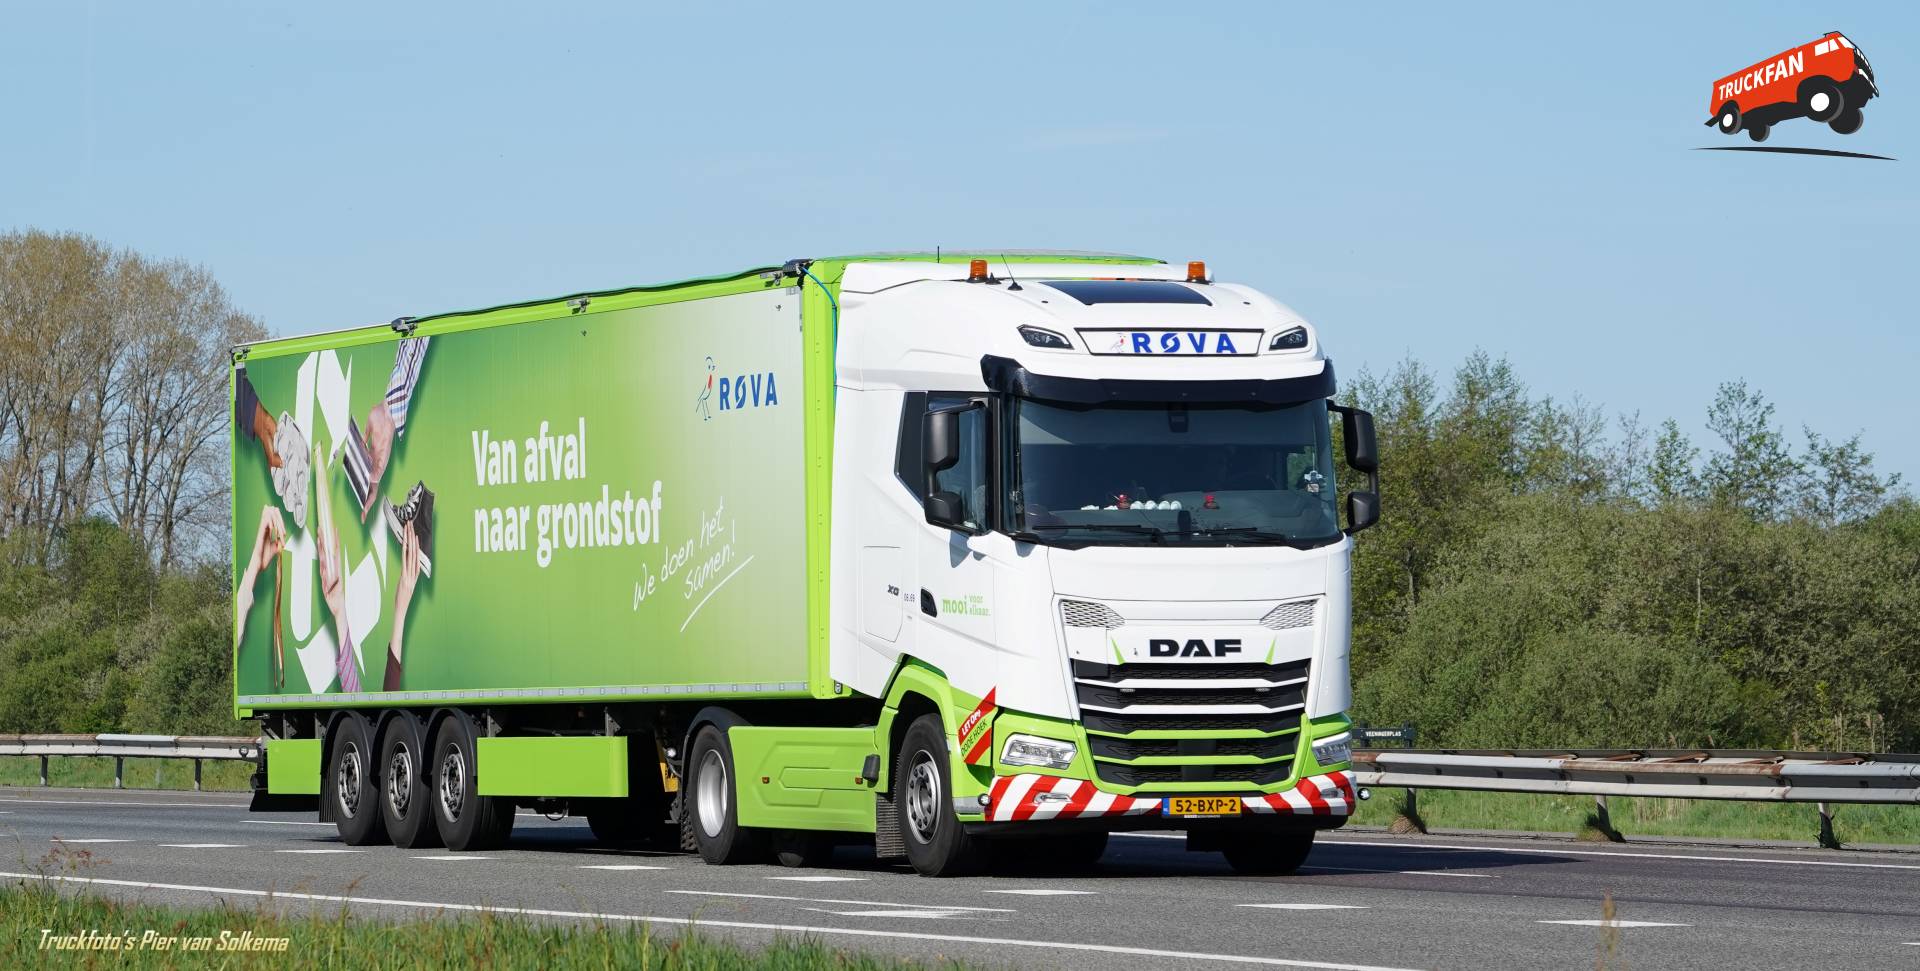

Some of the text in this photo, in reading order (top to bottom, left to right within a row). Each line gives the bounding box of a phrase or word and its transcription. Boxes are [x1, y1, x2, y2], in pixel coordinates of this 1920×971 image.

[472, 416, 586, 486] Van afval
[475, 480, 662, 568] naar grondstof
[633, 496, 725, 612] We doen het
[942, 595, 968, 615] mooi
[1149, 639, 1242, 657] DAF
[973, 719, 987, 738] HOEK
[1175, 799, 1237, 813] 52-BXP-2
